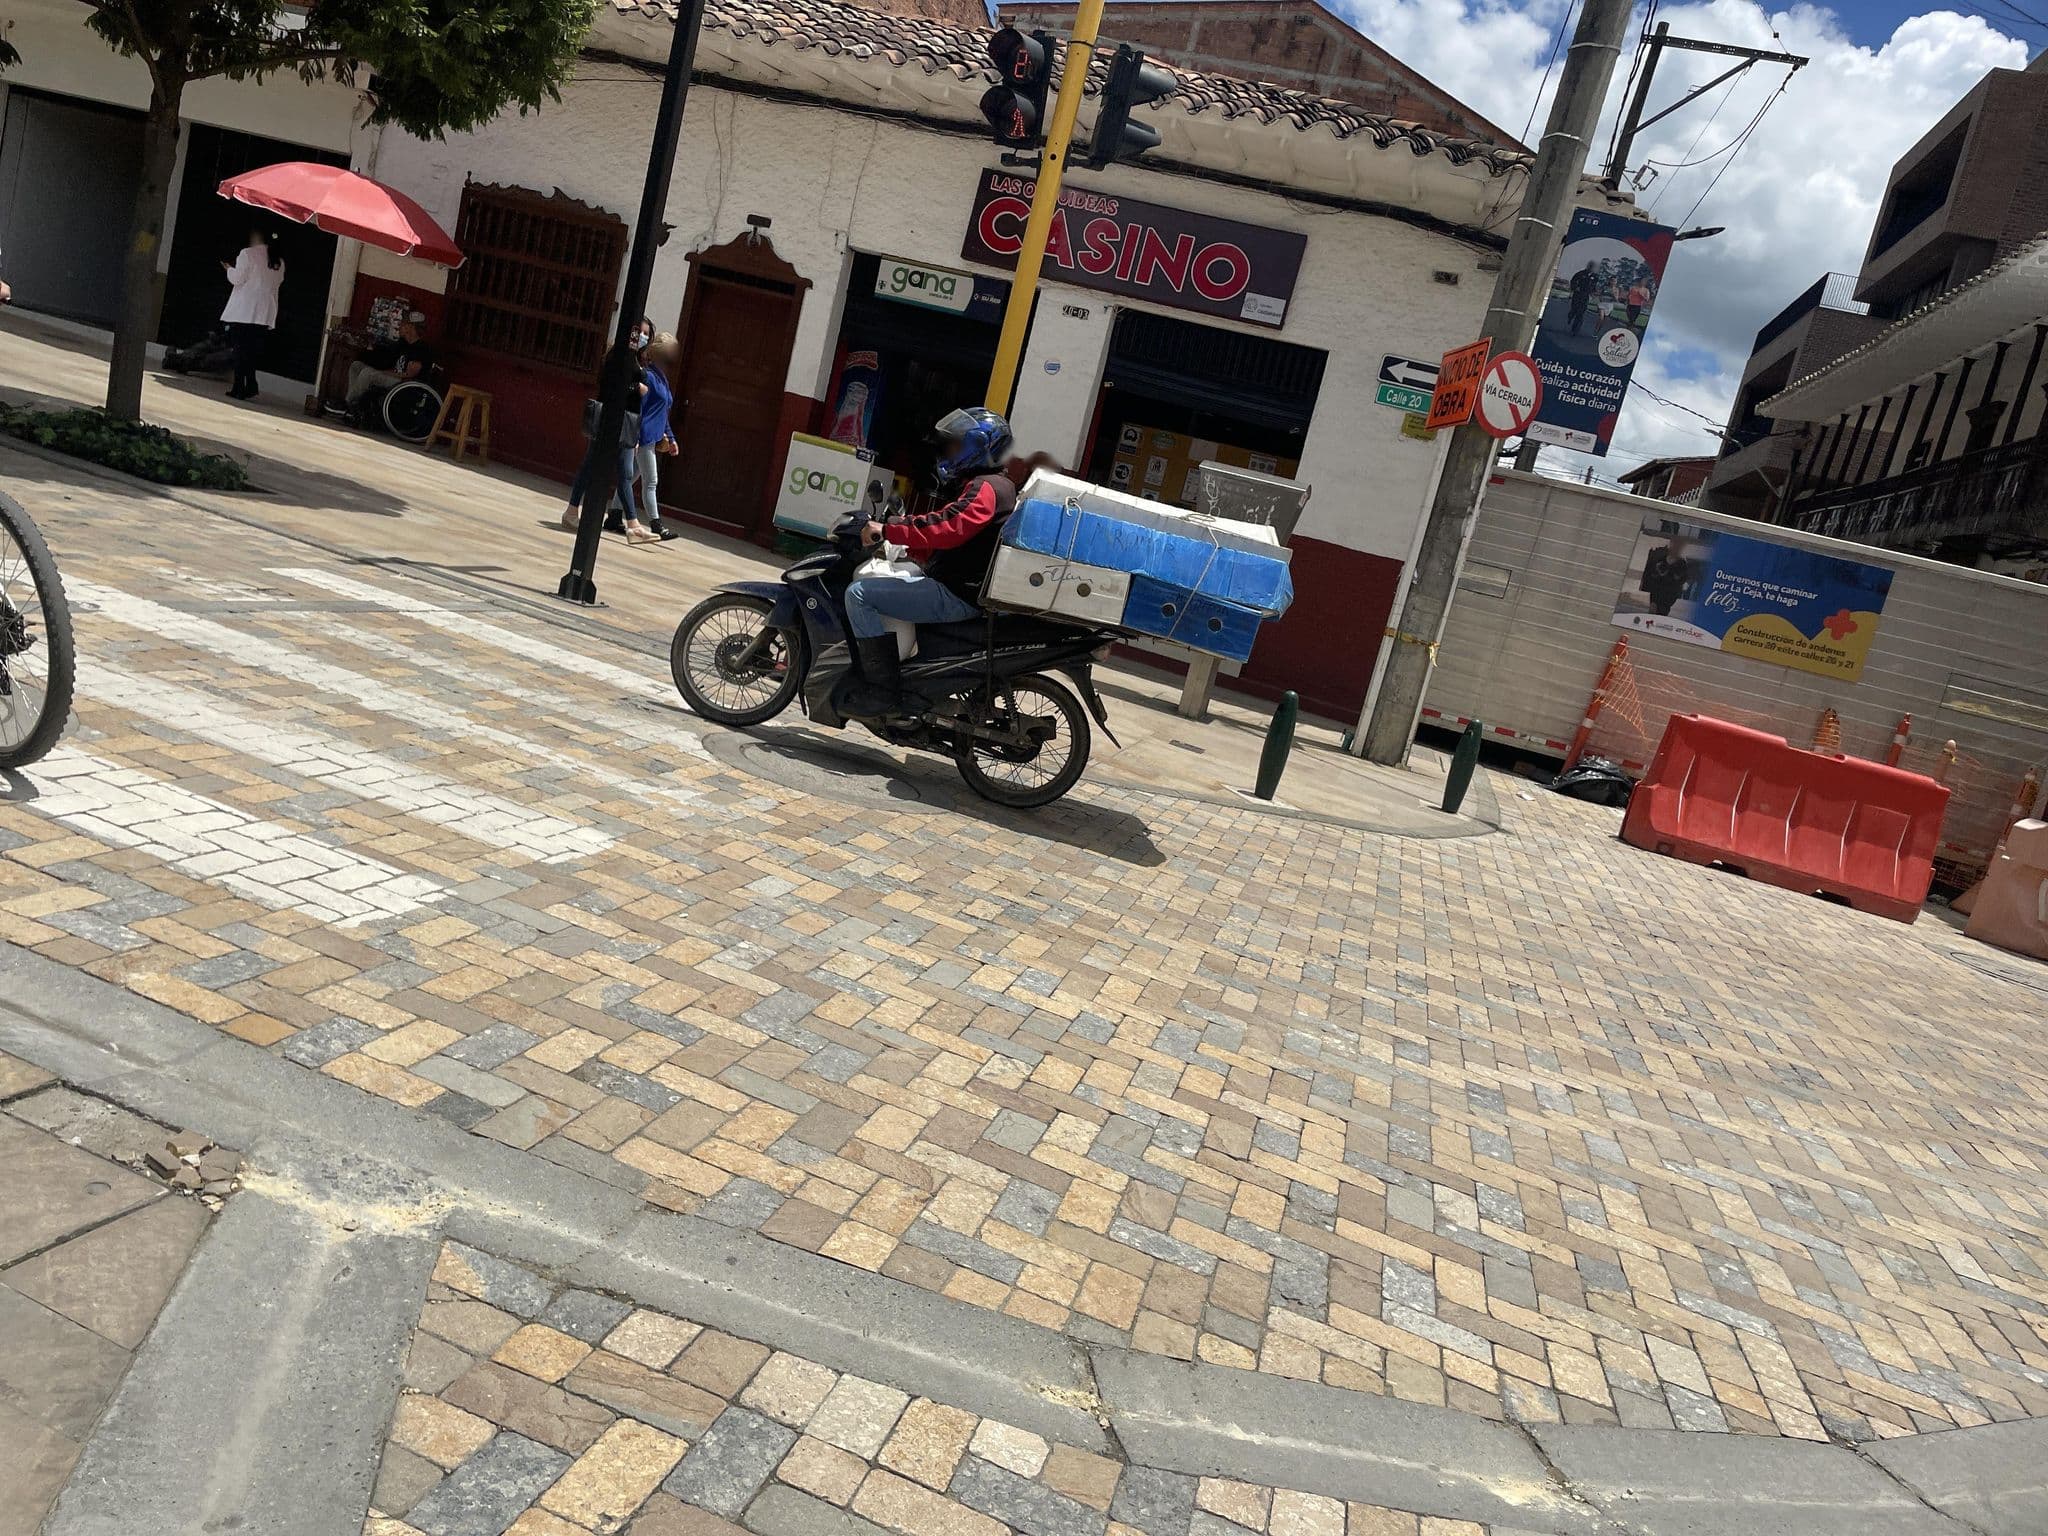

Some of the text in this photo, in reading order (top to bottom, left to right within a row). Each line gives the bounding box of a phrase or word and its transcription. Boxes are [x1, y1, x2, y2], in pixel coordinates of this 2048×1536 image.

[990, 174, 1119, 216] LAS OUIDEAS
[978, 197, 1251, 301] CASINO
[890, 266, 957, 295] gana
[1062, 304, 1090, 320] 20-03
[1466, 350, 1485, 379] DE
[1535, 358, 1623, 388] Cuida tu corazón,
[1386, 389, 1422, 408] Calle 20
[1434, 388, 1467, 418] OBRA
[1498, 390, 1532, 409] CERRADA
[1558, 390, 1617, 413] física diaria
[1571, 382, 1622, 400] actividad
[789, 466, 859, 501] gana
[1712, 581, 1798, 607] por La Ceja, te haga
[1716, 569, 1819, 600] Queremos que caminar
[1734, 636, 1764, 648] carrera
[1845, 660, 1855, 669] 21
